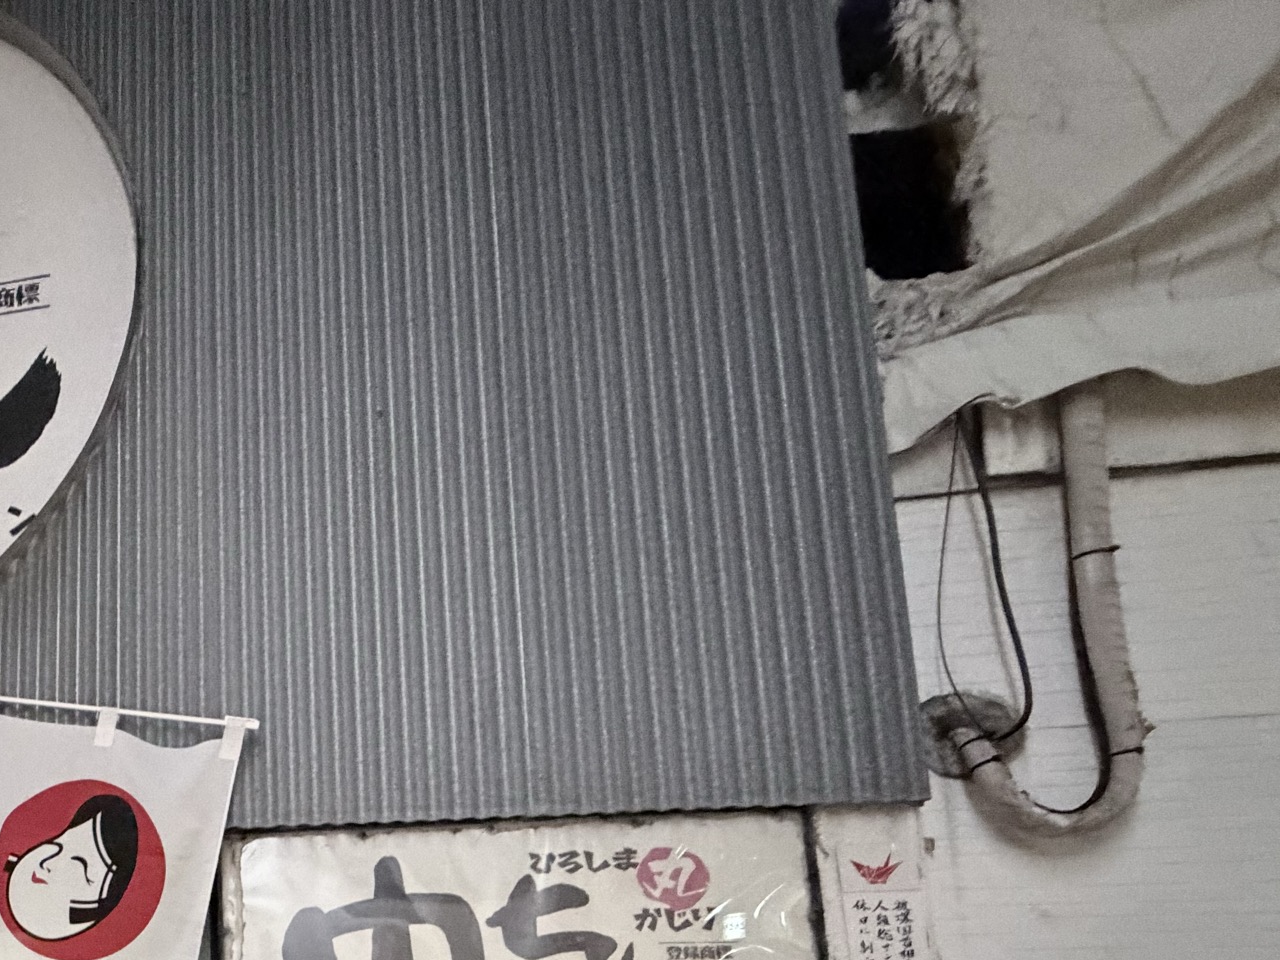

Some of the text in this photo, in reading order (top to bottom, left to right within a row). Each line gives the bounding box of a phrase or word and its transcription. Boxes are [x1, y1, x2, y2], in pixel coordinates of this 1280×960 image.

[528, 848, 640, 874] ひろしま
[633, 906, 717, 932] かじり
